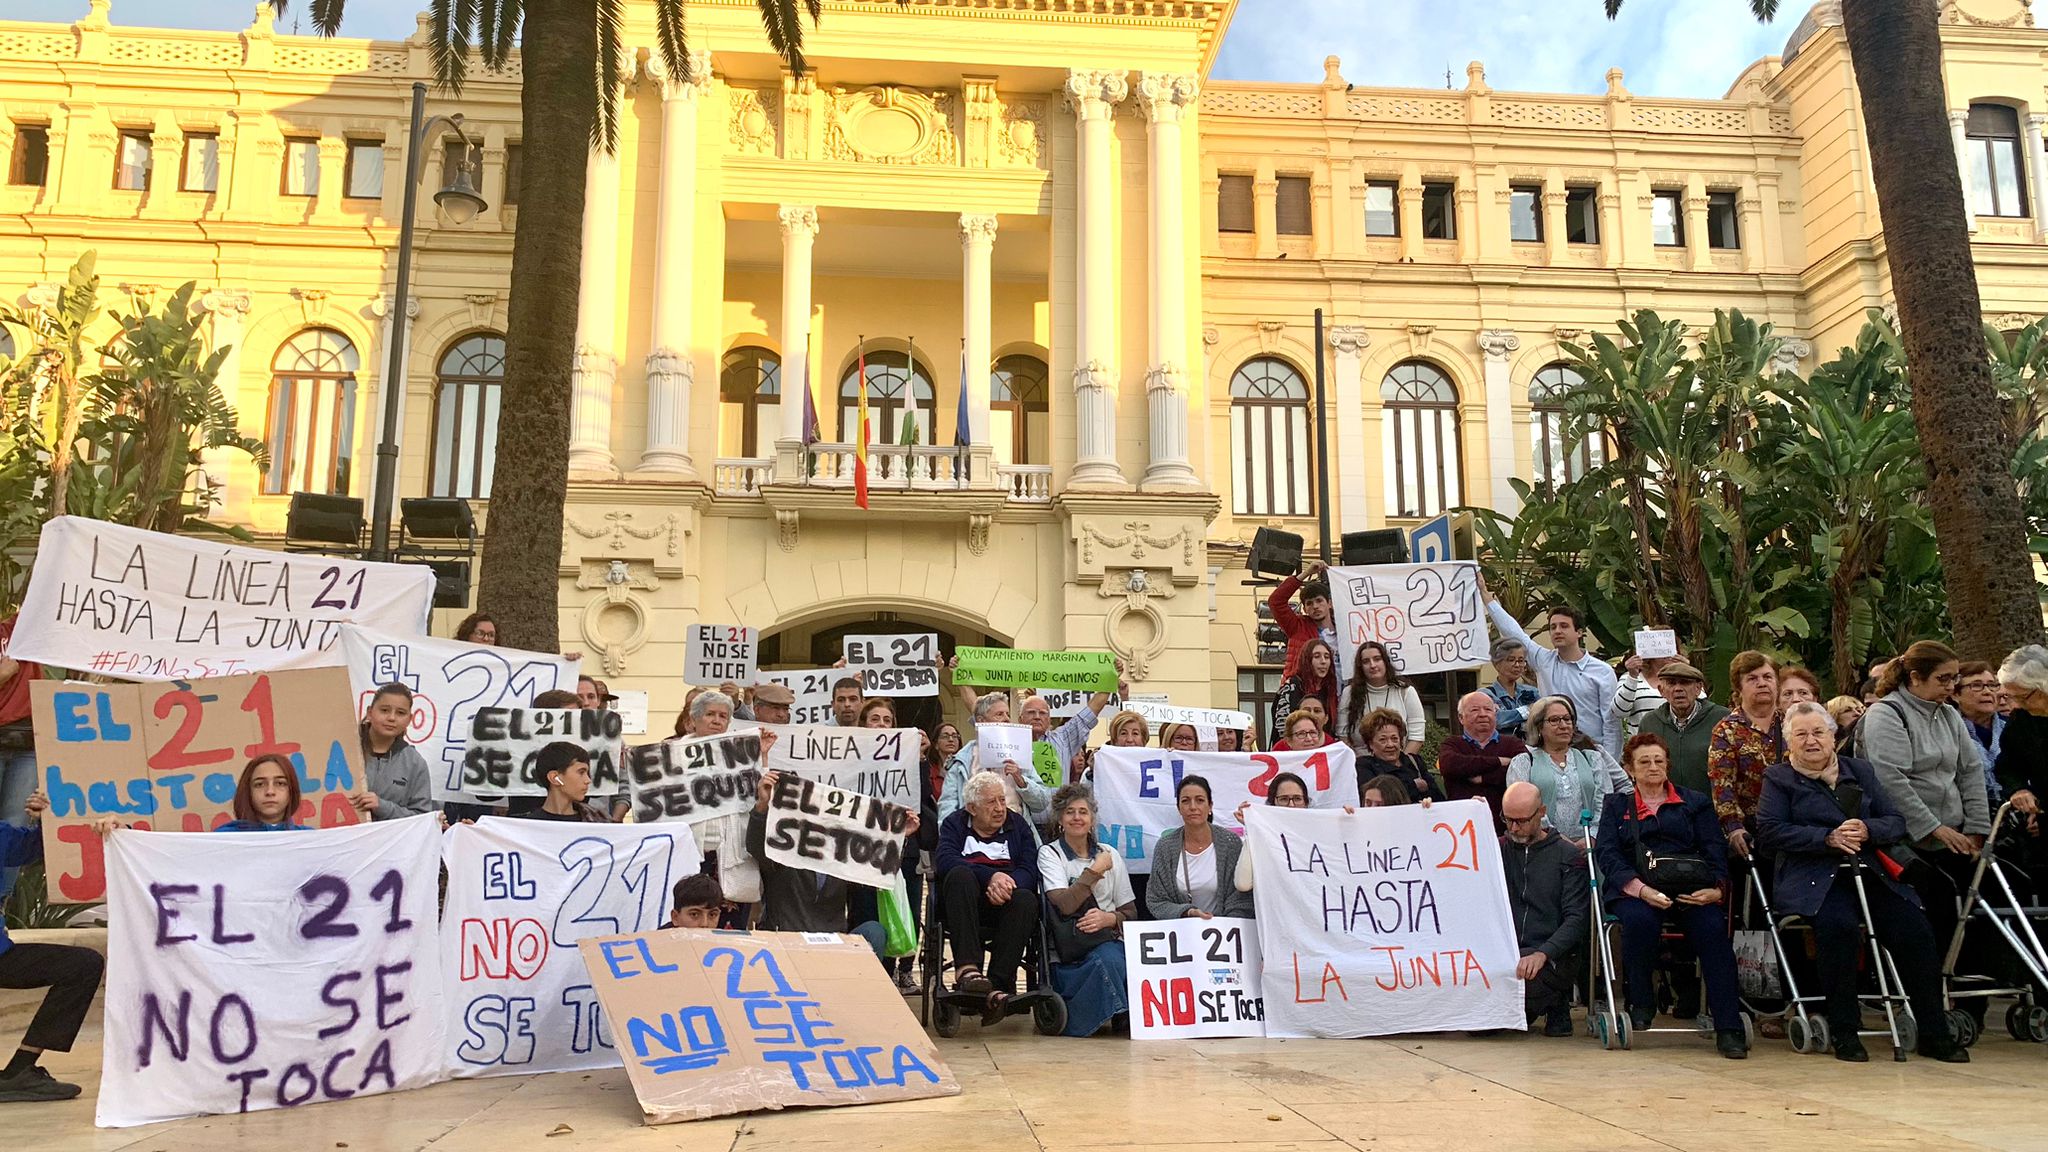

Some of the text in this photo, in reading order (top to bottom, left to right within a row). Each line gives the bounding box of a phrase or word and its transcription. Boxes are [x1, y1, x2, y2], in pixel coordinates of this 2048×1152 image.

[91, 535, 366, 611] LA LÍNEA 21
[1348, 565, 1477, 627] EL 21
[56, 582, 339, 651] HASTA LA JUNT
[699, 626, 747, 642] EL 21
[1349, 606, 1405, 644] NO
[699, 661, 746, 680] TOCA
[703, 644, 750, 659] NO SE
[848, 635, 936, 667] EL 21
[960, 648, 1111, 664] AYUNTAMIENTO MARGINA LA
[372, 644, 558, 743] EL 21
[803, 675, 828, 694] 21
[956, 669, 1100, 684] BDA JUNTA DE LOS CAMINOS
[54, 674, 301, 770] EL 21
[359, 691, 437, 743] O
[473, 707, 531, 740] EL
[534, 711, 572, 735] 21
[580, 709, 622, 741] NO
[1143, 706, 1155, 718] 21
[1160, 709, 1174, 721] NO
[1180, 711, 1194, 722] SE
[1202, 711, 1231, 725] TOCA
[291, 740, 353, 793] LA
[464, 747, 513, 788] SE
[632, 743, 683, 784] EL
[685, 742, 716, 769] 21
[720, 735, 761, 769] NO
[790, 730, 902, 762] LÍNEA 21
[1041, 744, 1053, 757] 21
[1045, 760, 1057, 770] SE
[1248, 752, 1331, 797] 21
[636, 784, 693, 822] SE
[772, 773, 907, 834] EL 21 NO
[767, 818, 826, 860] SE
[1097, 824, 1145, 859] NO
[1280, 818, 1480, 878] LA LÍNEA 21
[150, 868, 413, 946] EL 21
[484, 834, 674, 947] EL 21
[1322, 879, 1442, 935] HASTA
[461, 918, 549, 981] NO
[599, 938, 808, 999] EL 21
[1140, 928, 1243, 965] EL 21
[1293, 946, 1491, 1004] LA JUNTA
[136, 961, 412, 1068] NO SE
[1141, 977, 1196, 1028] NO
[1199, 990, 1229, 1023] SE
[457, 994, 536, 1065] SE
[626, 999, 845, 1056] NO SE
[227, 1038, 396, 1113] TOCA
[763, 1044, 940, 1090] TOCA
